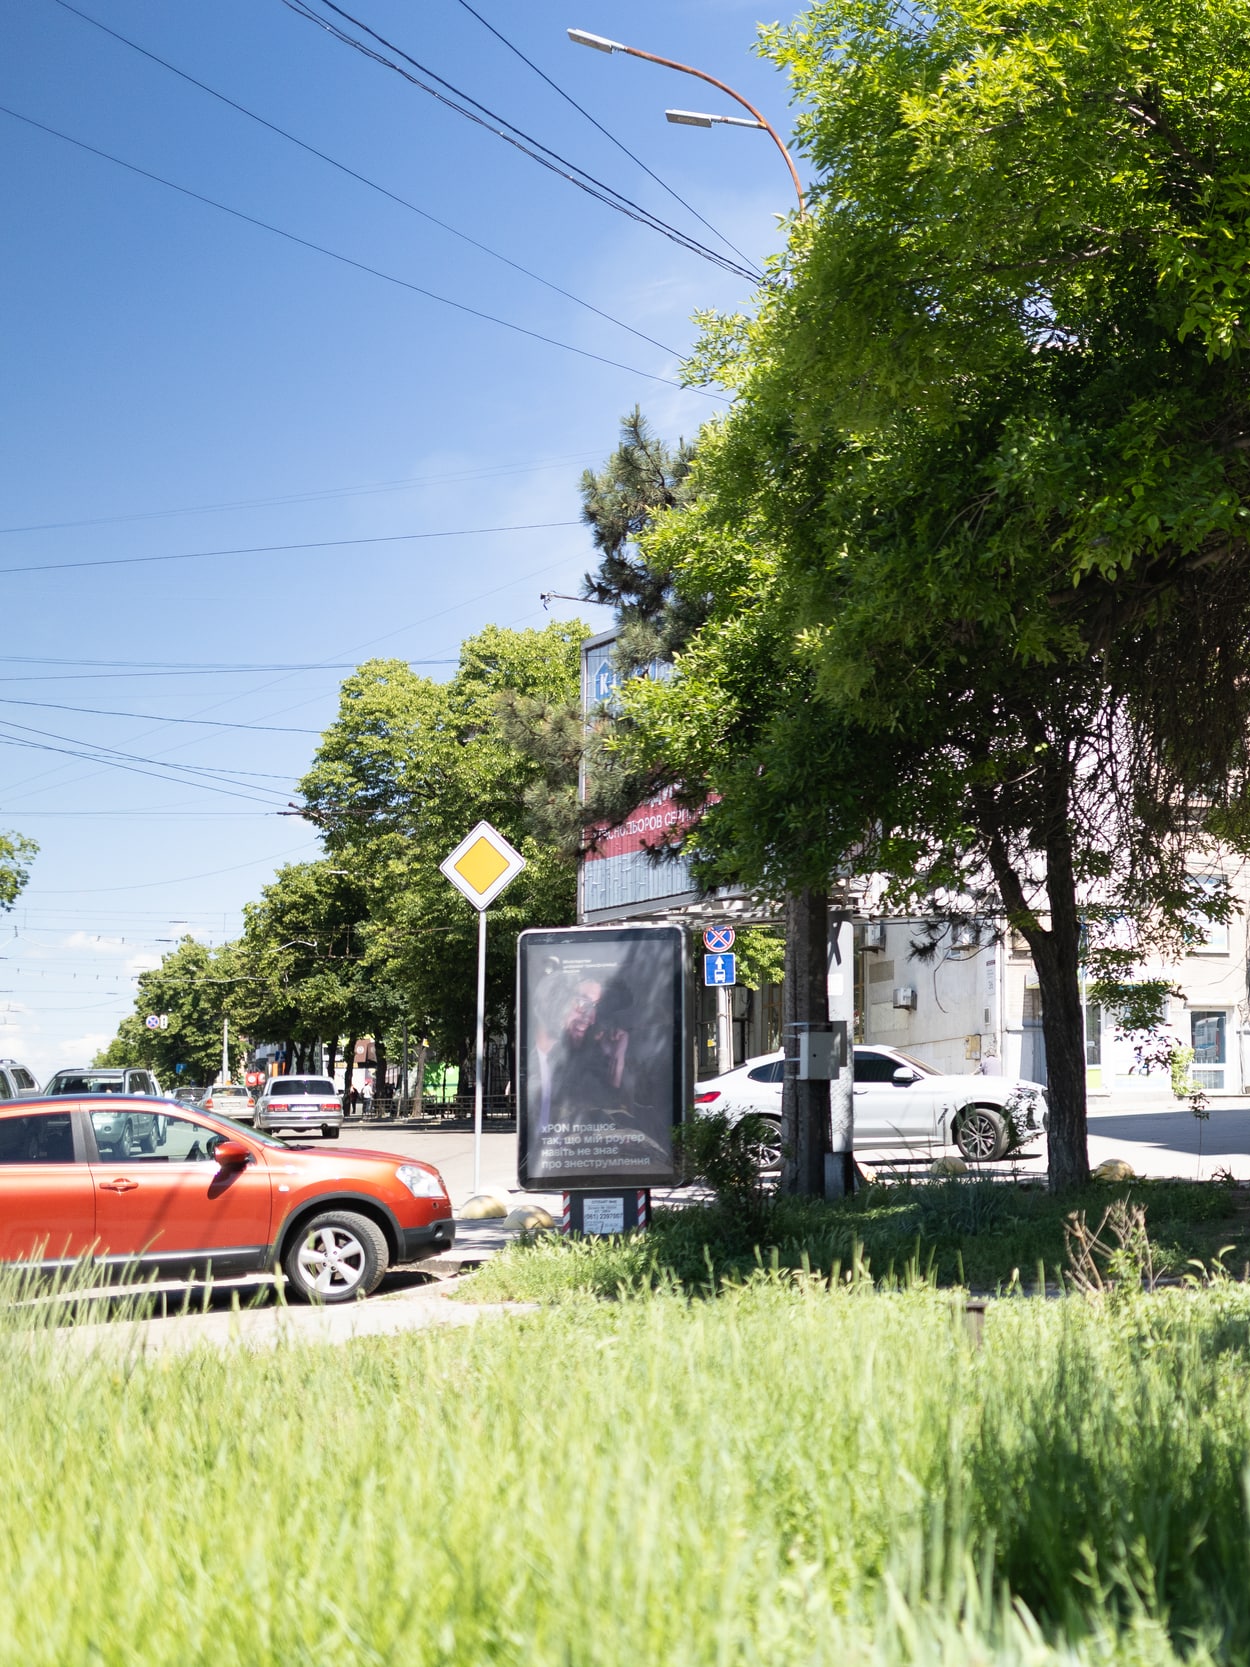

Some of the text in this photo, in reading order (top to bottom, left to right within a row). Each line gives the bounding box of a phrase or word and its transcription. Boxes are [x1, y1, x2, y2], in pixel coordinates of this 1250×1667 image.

[572, 1122, 616, 1134] працює
[541, 1133, 646, 1146] так, що мій роутер
[541, 1146, 619, 1157] навіть не знає
[541, 1157, 650, 1171] про знеструмлення
